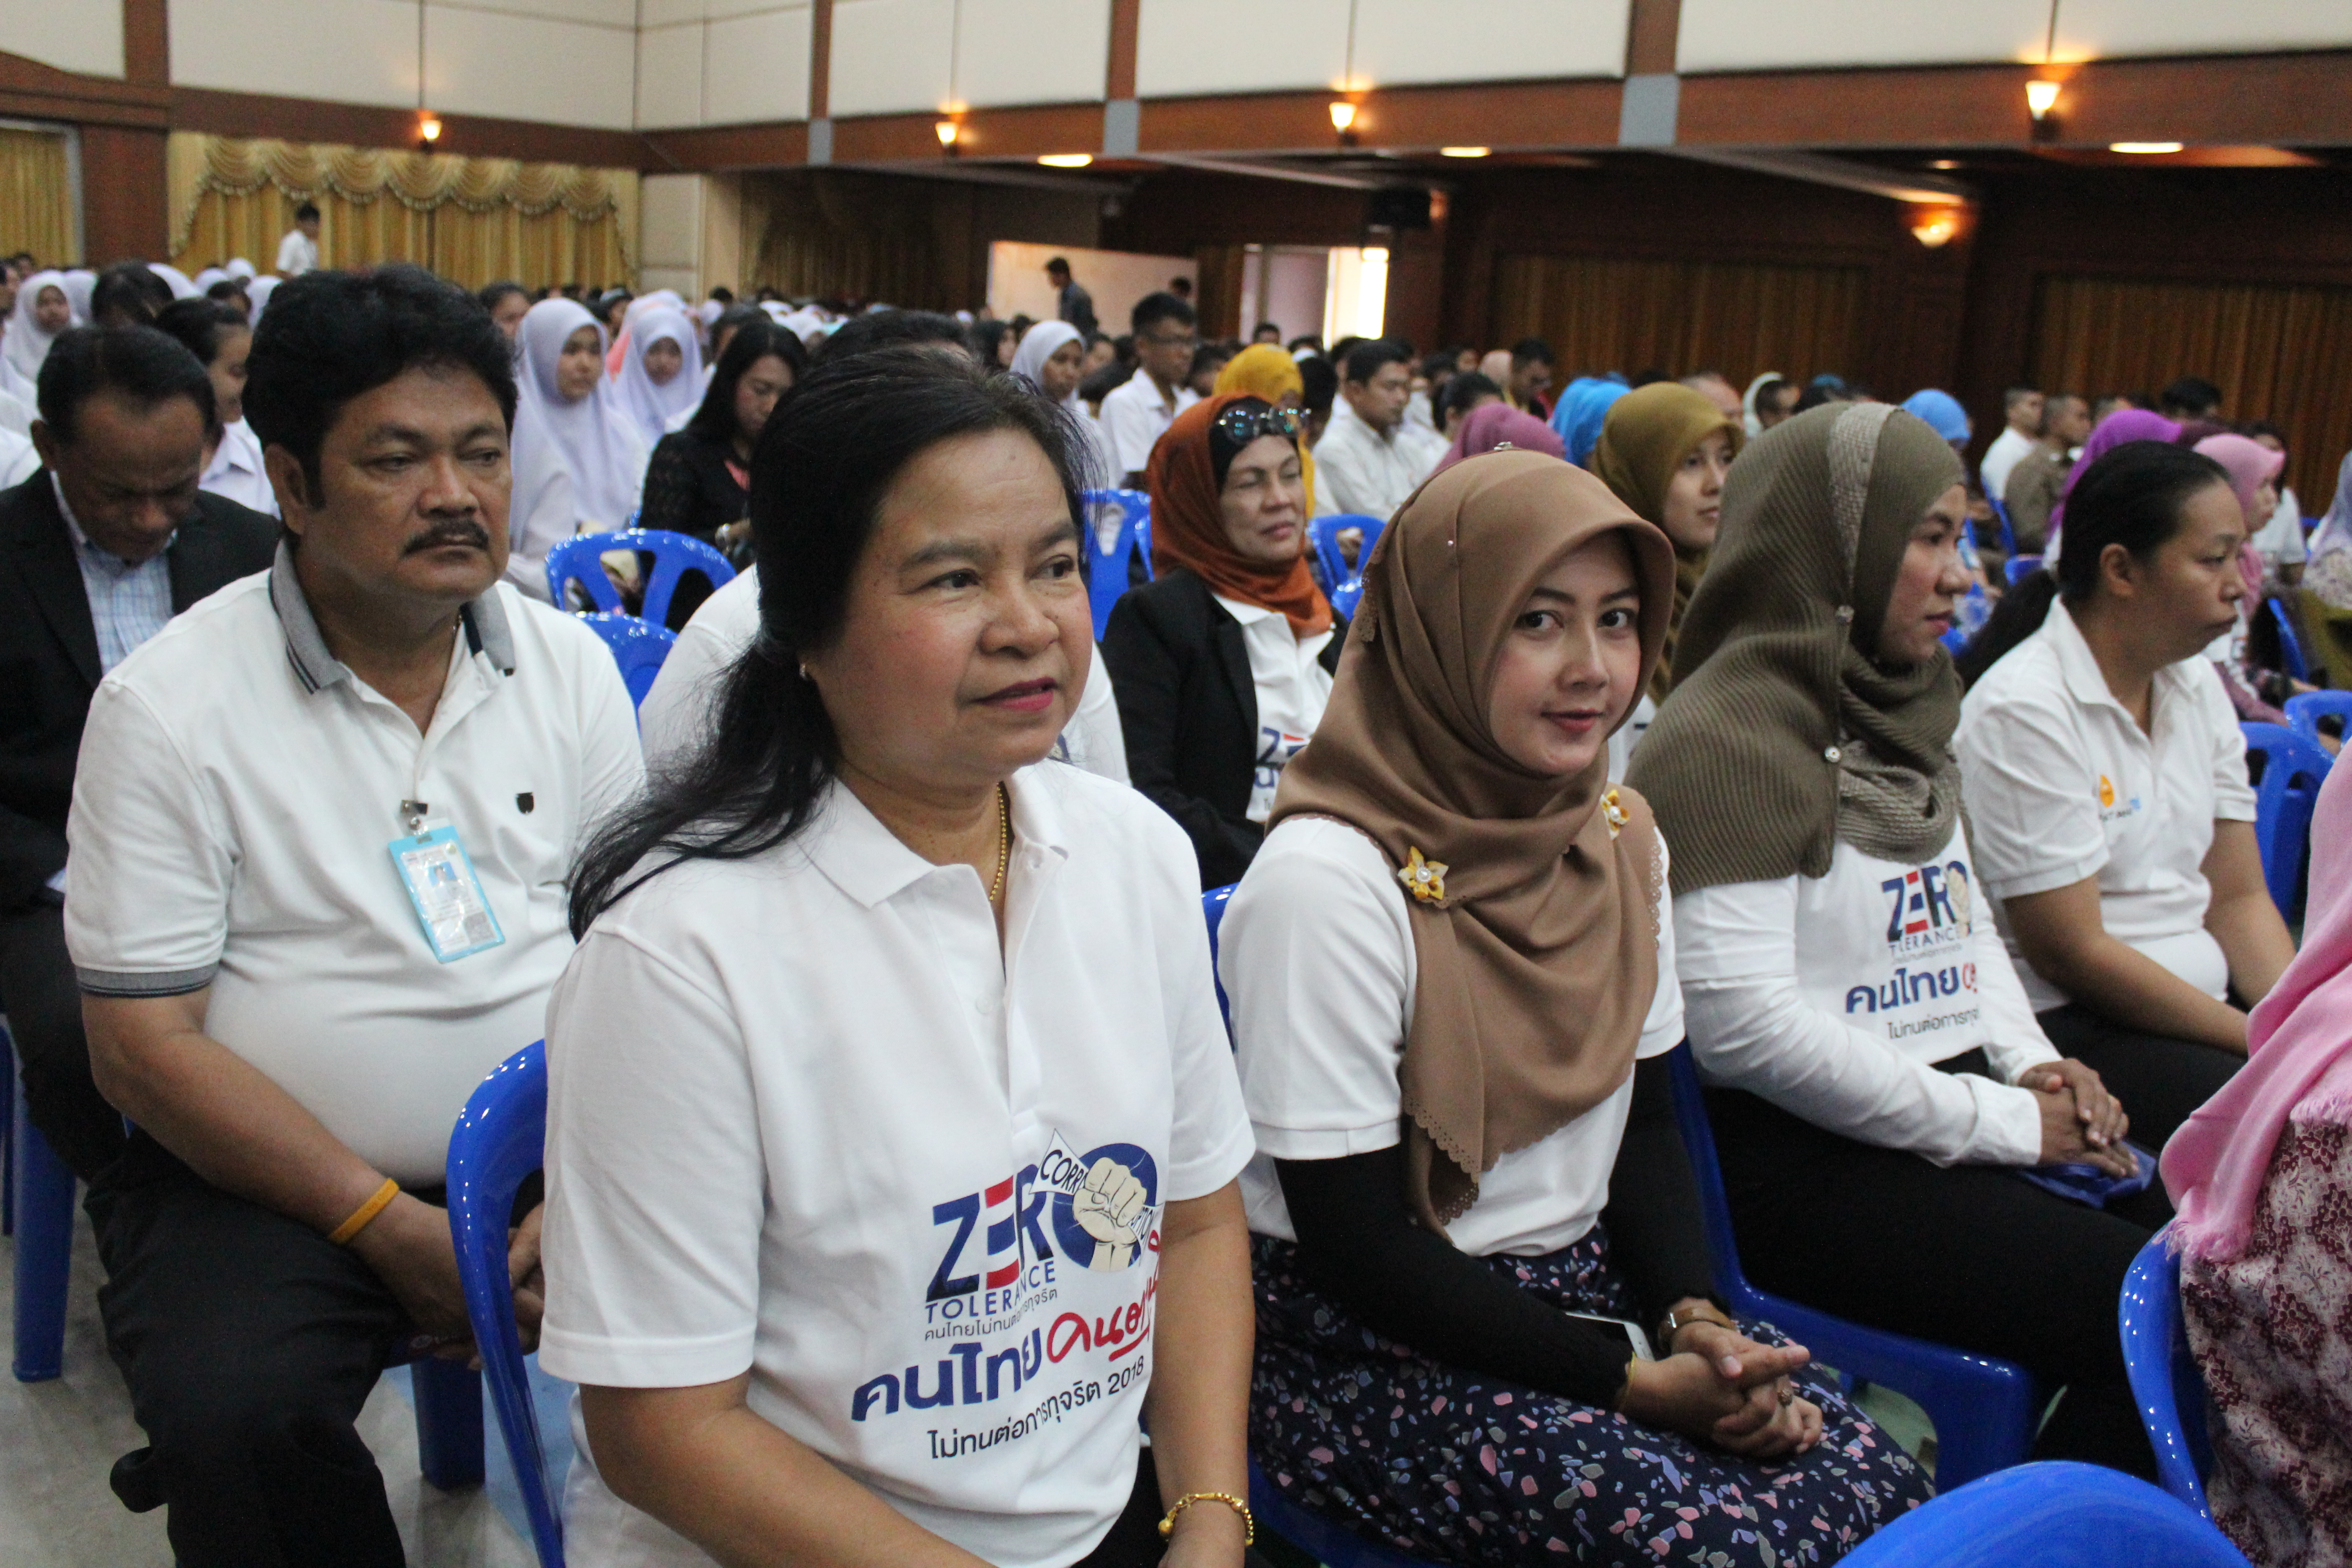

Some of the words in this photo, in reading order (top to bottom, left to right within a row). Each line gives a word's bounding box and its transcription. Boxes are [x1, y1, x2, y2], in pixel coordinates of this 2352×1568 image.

[1846, 966, 1959, 1013] คนไทย
[926, 1143, 1157, 1302] ZERO
[926, 1261, 1055, 1323] TOLERANCE
[927, 1380, 1101, 1459] ไม่ทนต่อการทุจริต
[1108, 1355, 1144, 1396] 2018
